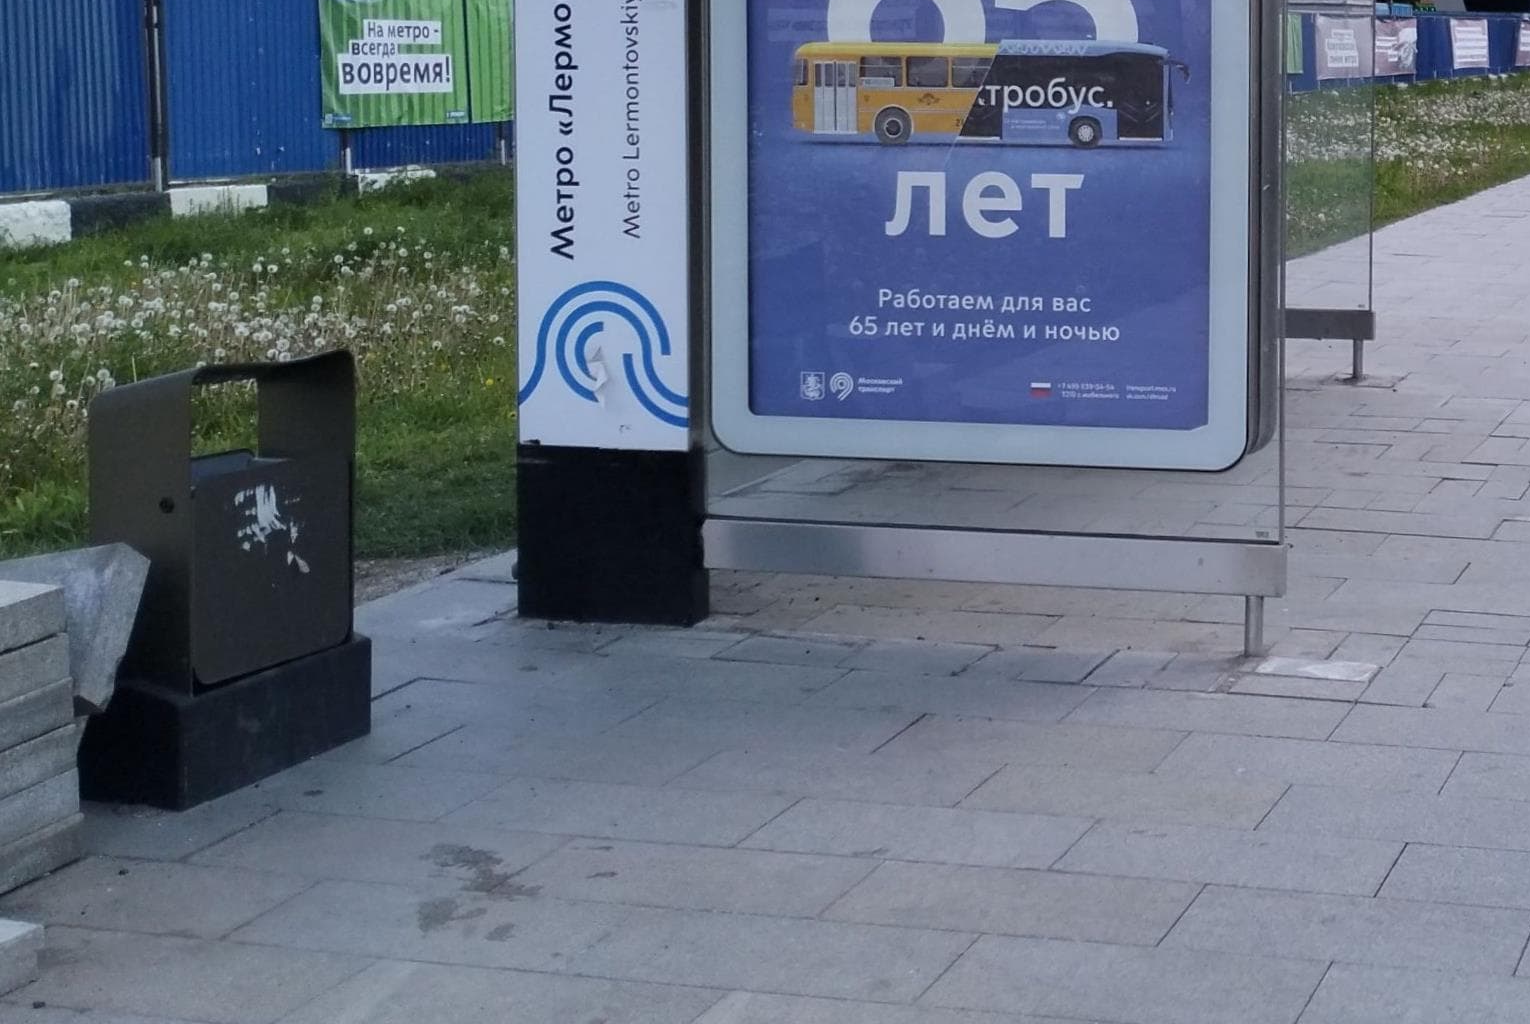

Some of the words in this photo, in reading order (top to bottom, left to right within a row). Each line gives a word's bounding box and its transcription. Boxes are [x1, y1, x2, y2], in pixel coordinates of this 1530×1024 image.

[367, 21, 384, 39] На
[387, 24, 430, 43] метро
[351, 41, 396, 58] всегда
[341, 55, 451, 91] вовремя!
[549, 147, 580, 261] Метро
[622, 168, 641, 239] Metro
[885, 170, 1085, 239] лет
[878, 288, 994, 310] Работаем
[1001, 296, 1044, 314] для
[1052, 297, 1092, 313] вас
[849, 315, 878, 336] 65
[884, 320, 925, 337] лет
[932, 322, 945, 337] и
[951, 319, 1015, 340] днём
[1023, 324, 1036, 339] и
[1045, 325, 1120, 341] ночью
